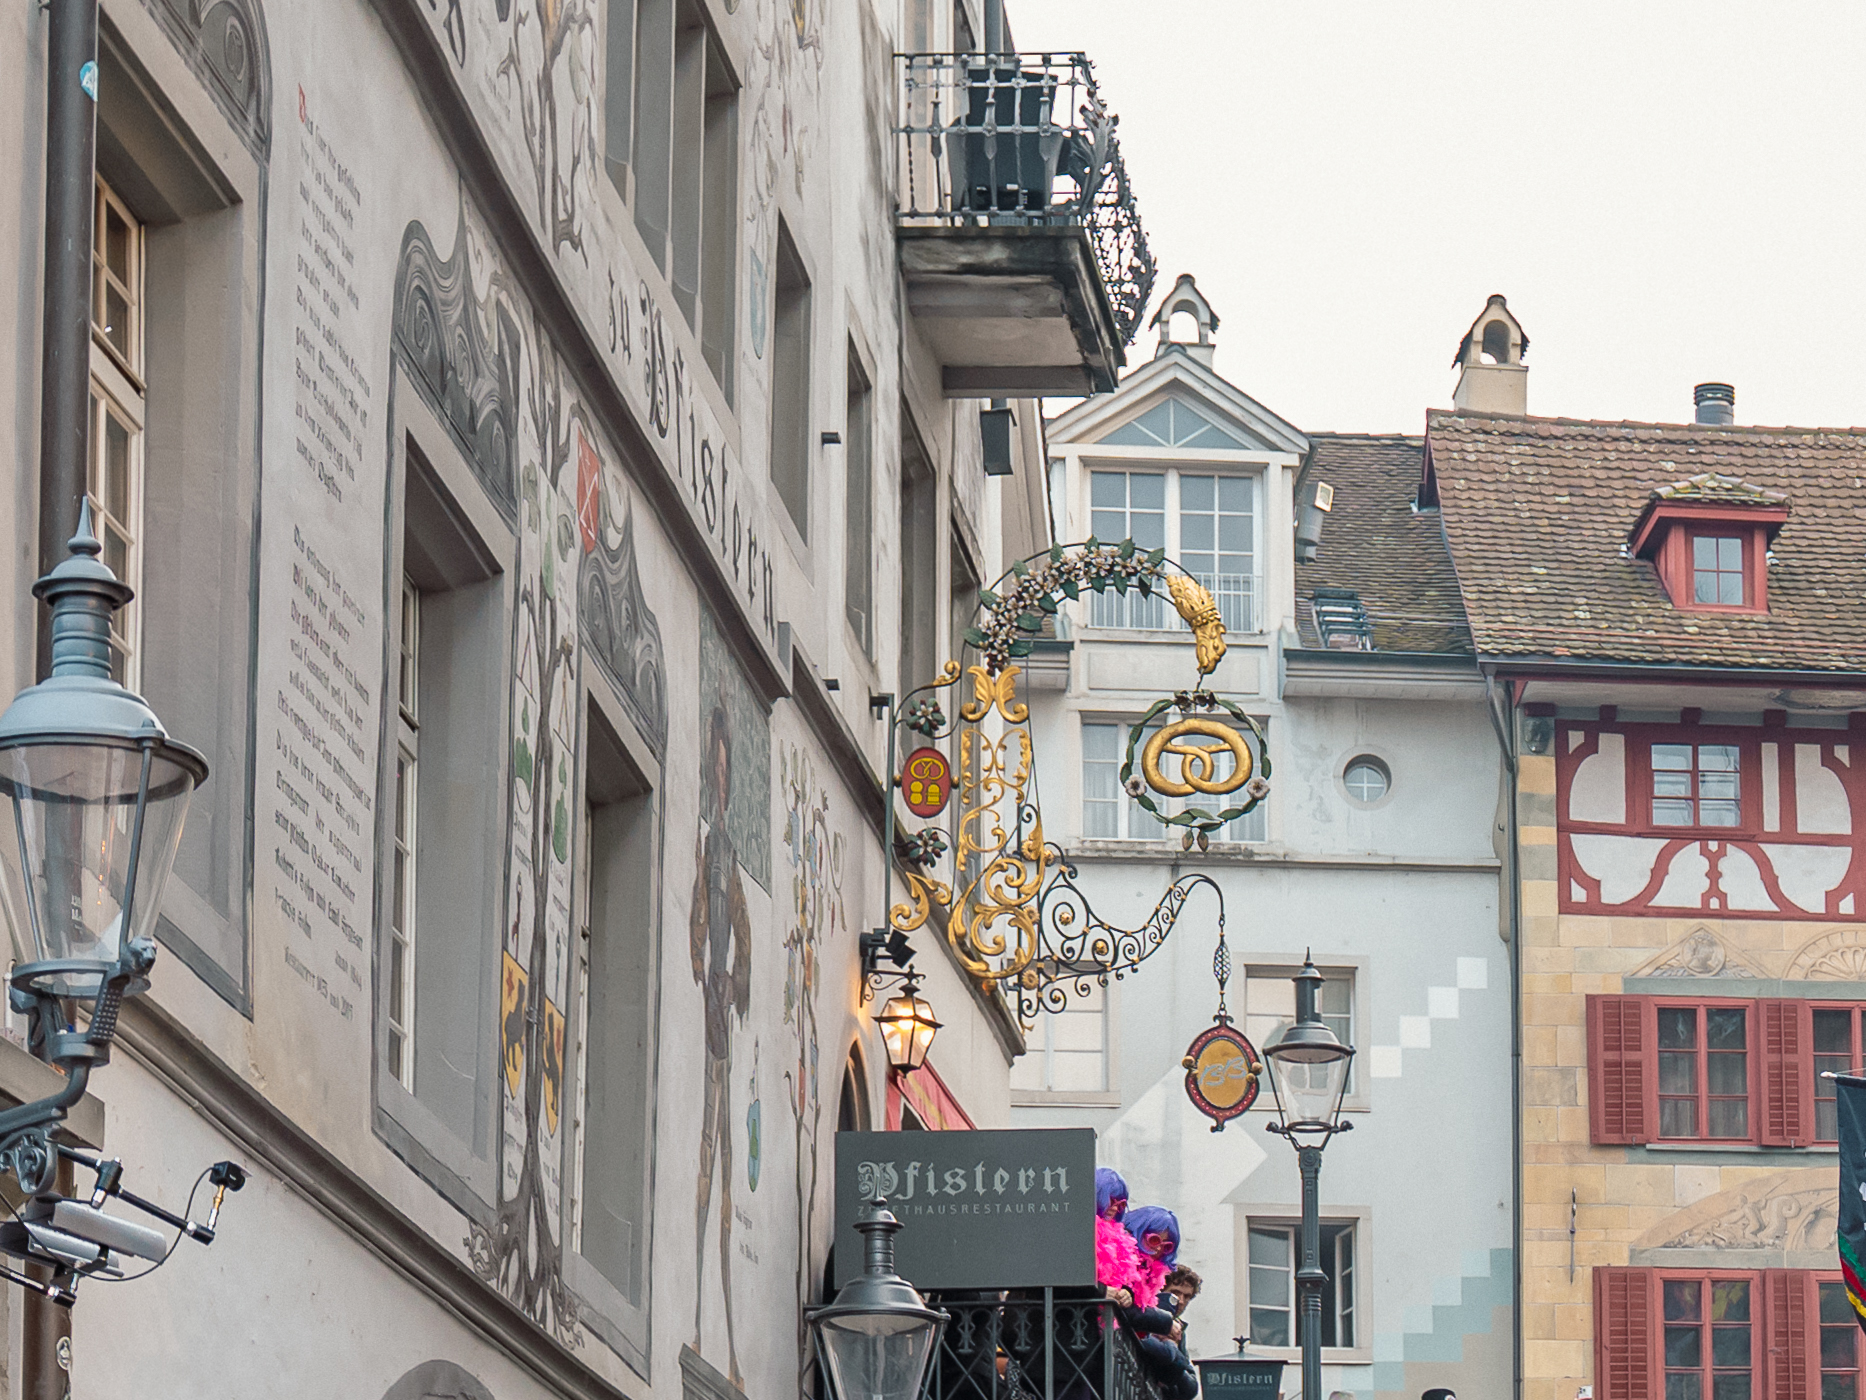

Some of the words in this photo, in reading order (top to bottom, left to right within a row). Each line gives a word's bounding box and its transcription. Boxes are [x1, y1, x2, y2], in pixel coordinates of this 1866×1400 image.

[638, 278, 777, 648] Pfistern
[857, 1160, 1071, 1201] Pfistern
[857, 1201, 1071, 1217] ZFTHAUSRESTAURANT
[1206, 1372, 1274, 1386] Pfistern
